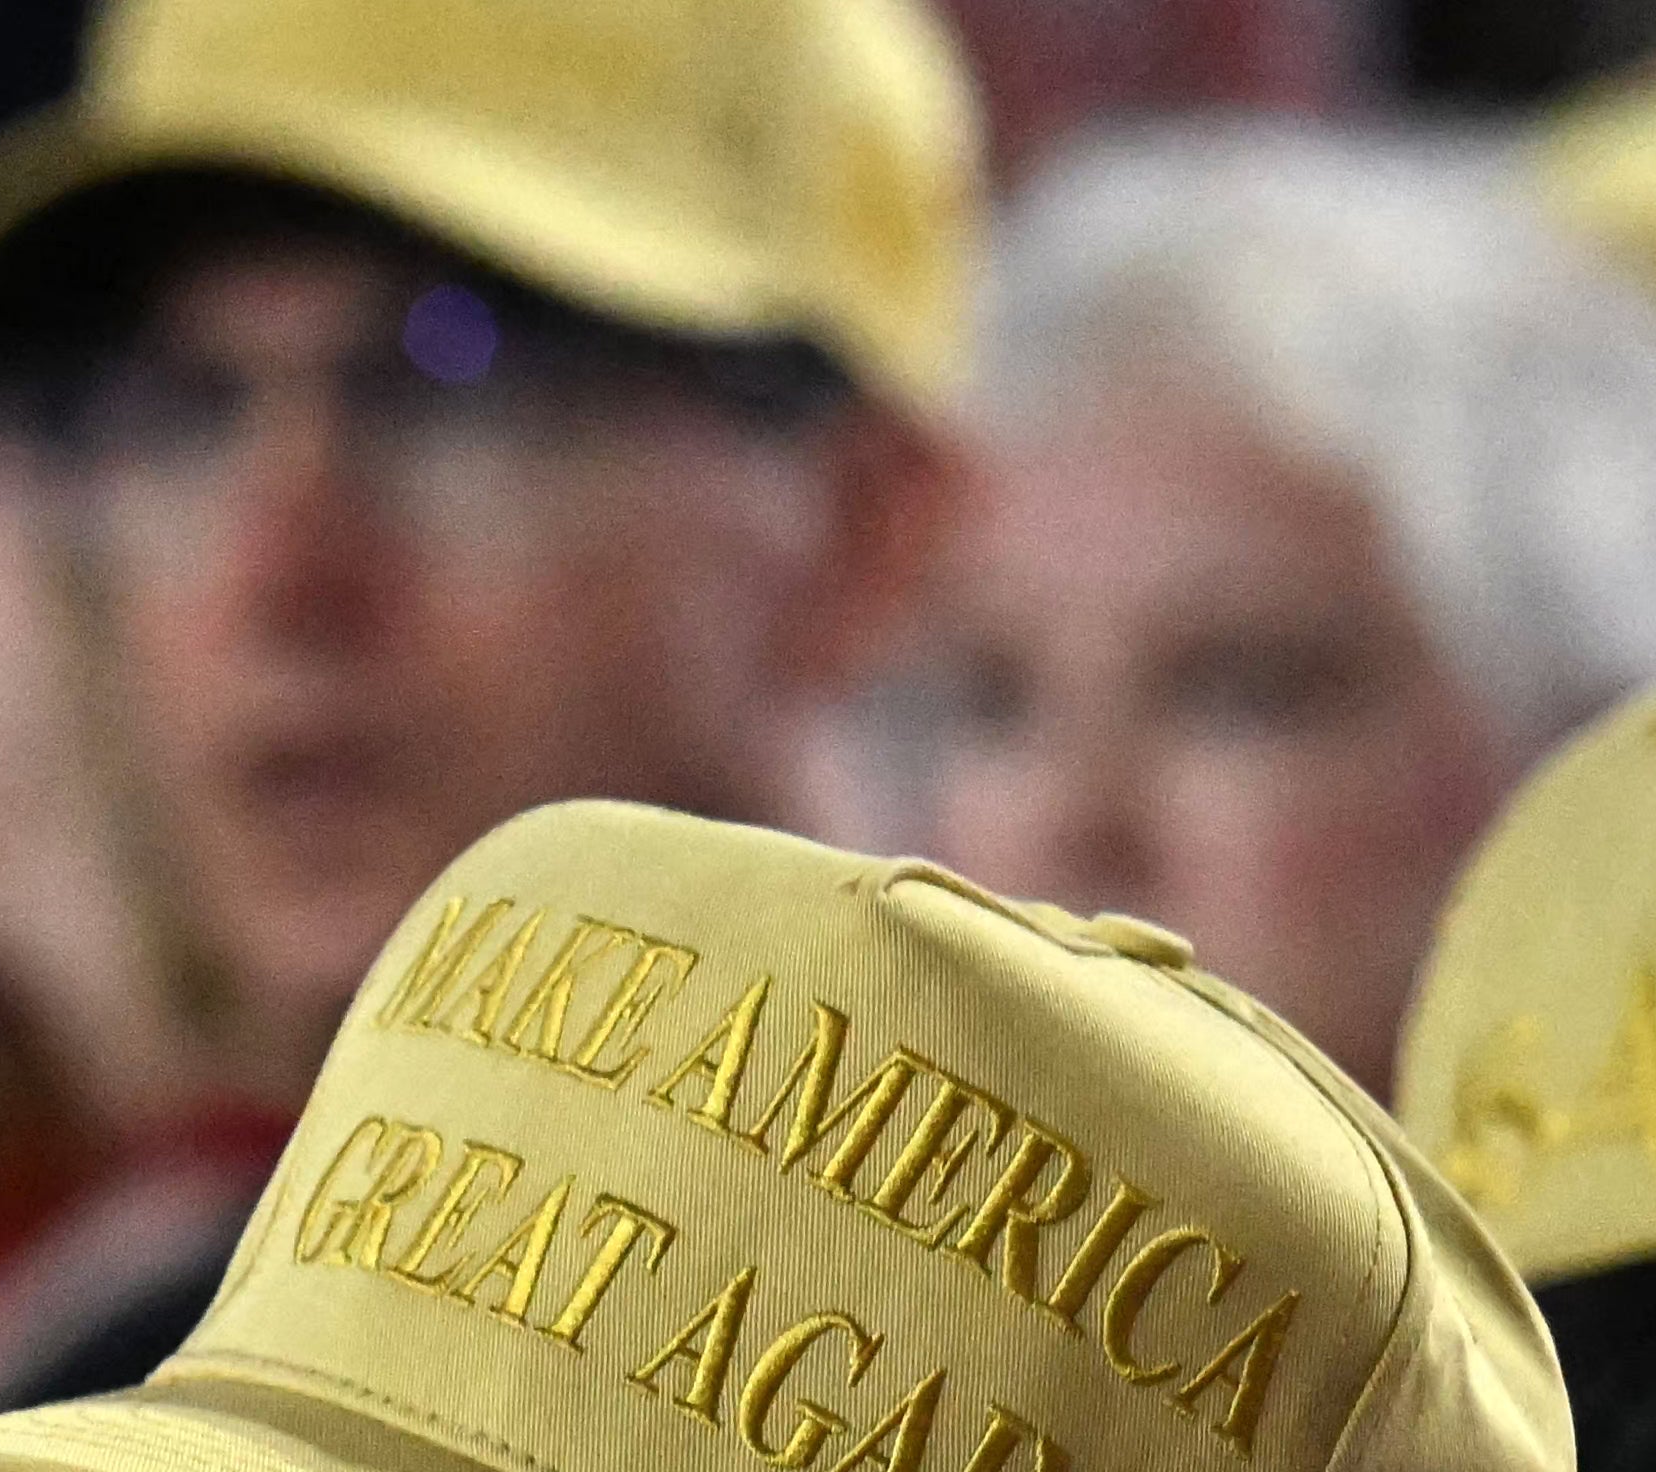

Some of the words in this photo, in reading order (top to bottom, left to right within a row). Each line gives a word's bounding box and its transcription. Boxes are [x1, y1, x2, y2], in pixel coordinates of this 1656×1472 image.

[294, 1112, 678, 1352] GREAT
[373, 893, 700, 1092] MAKE
[647, 971, 1303, 1460] AMERICA
